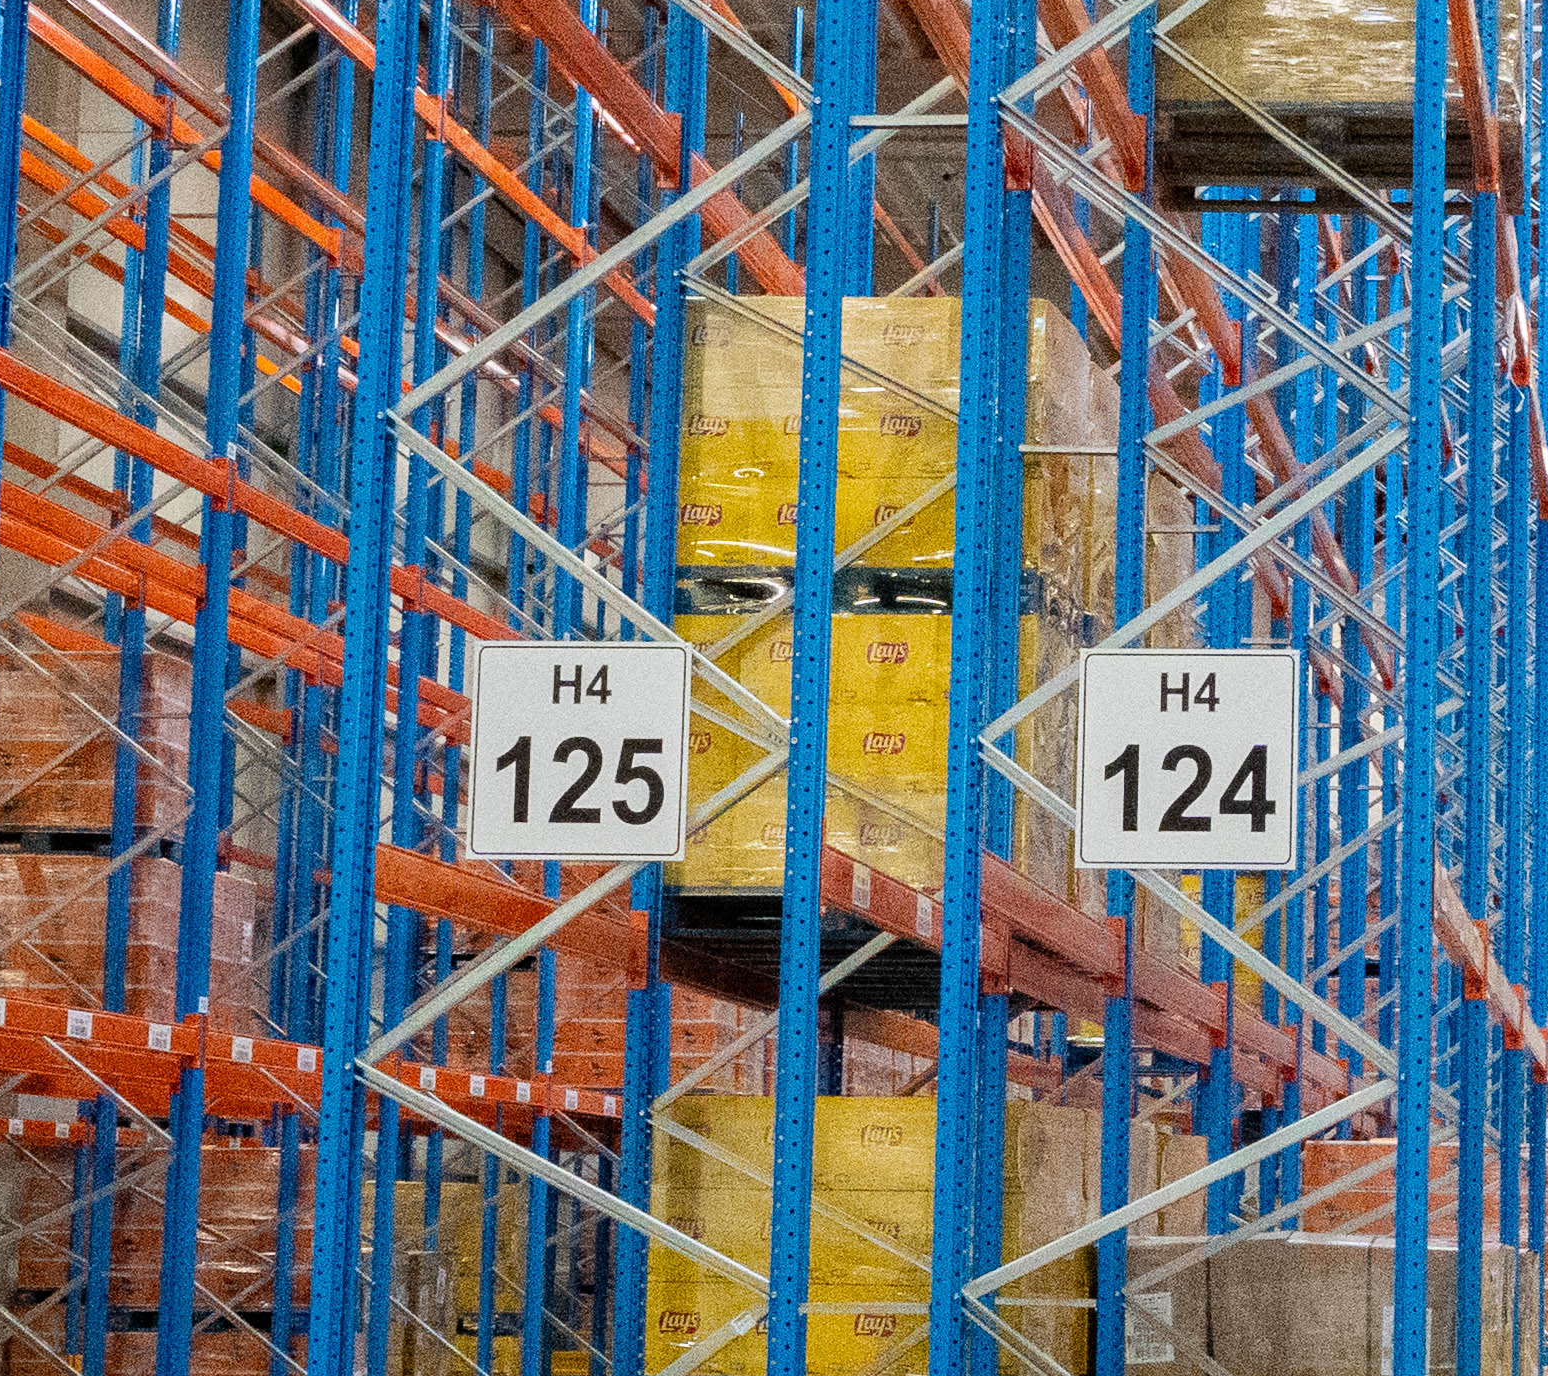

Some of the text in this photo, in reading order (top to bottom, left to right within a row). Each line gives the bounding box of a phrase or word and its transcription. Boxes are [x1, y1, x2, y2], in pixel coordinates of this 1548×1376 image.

[553, 665, 611, 704] H4
[1161, 673, 1219, 712] H4
[497, 736, 664, 825] 125
[1105, 745, 1275, 832] 124
